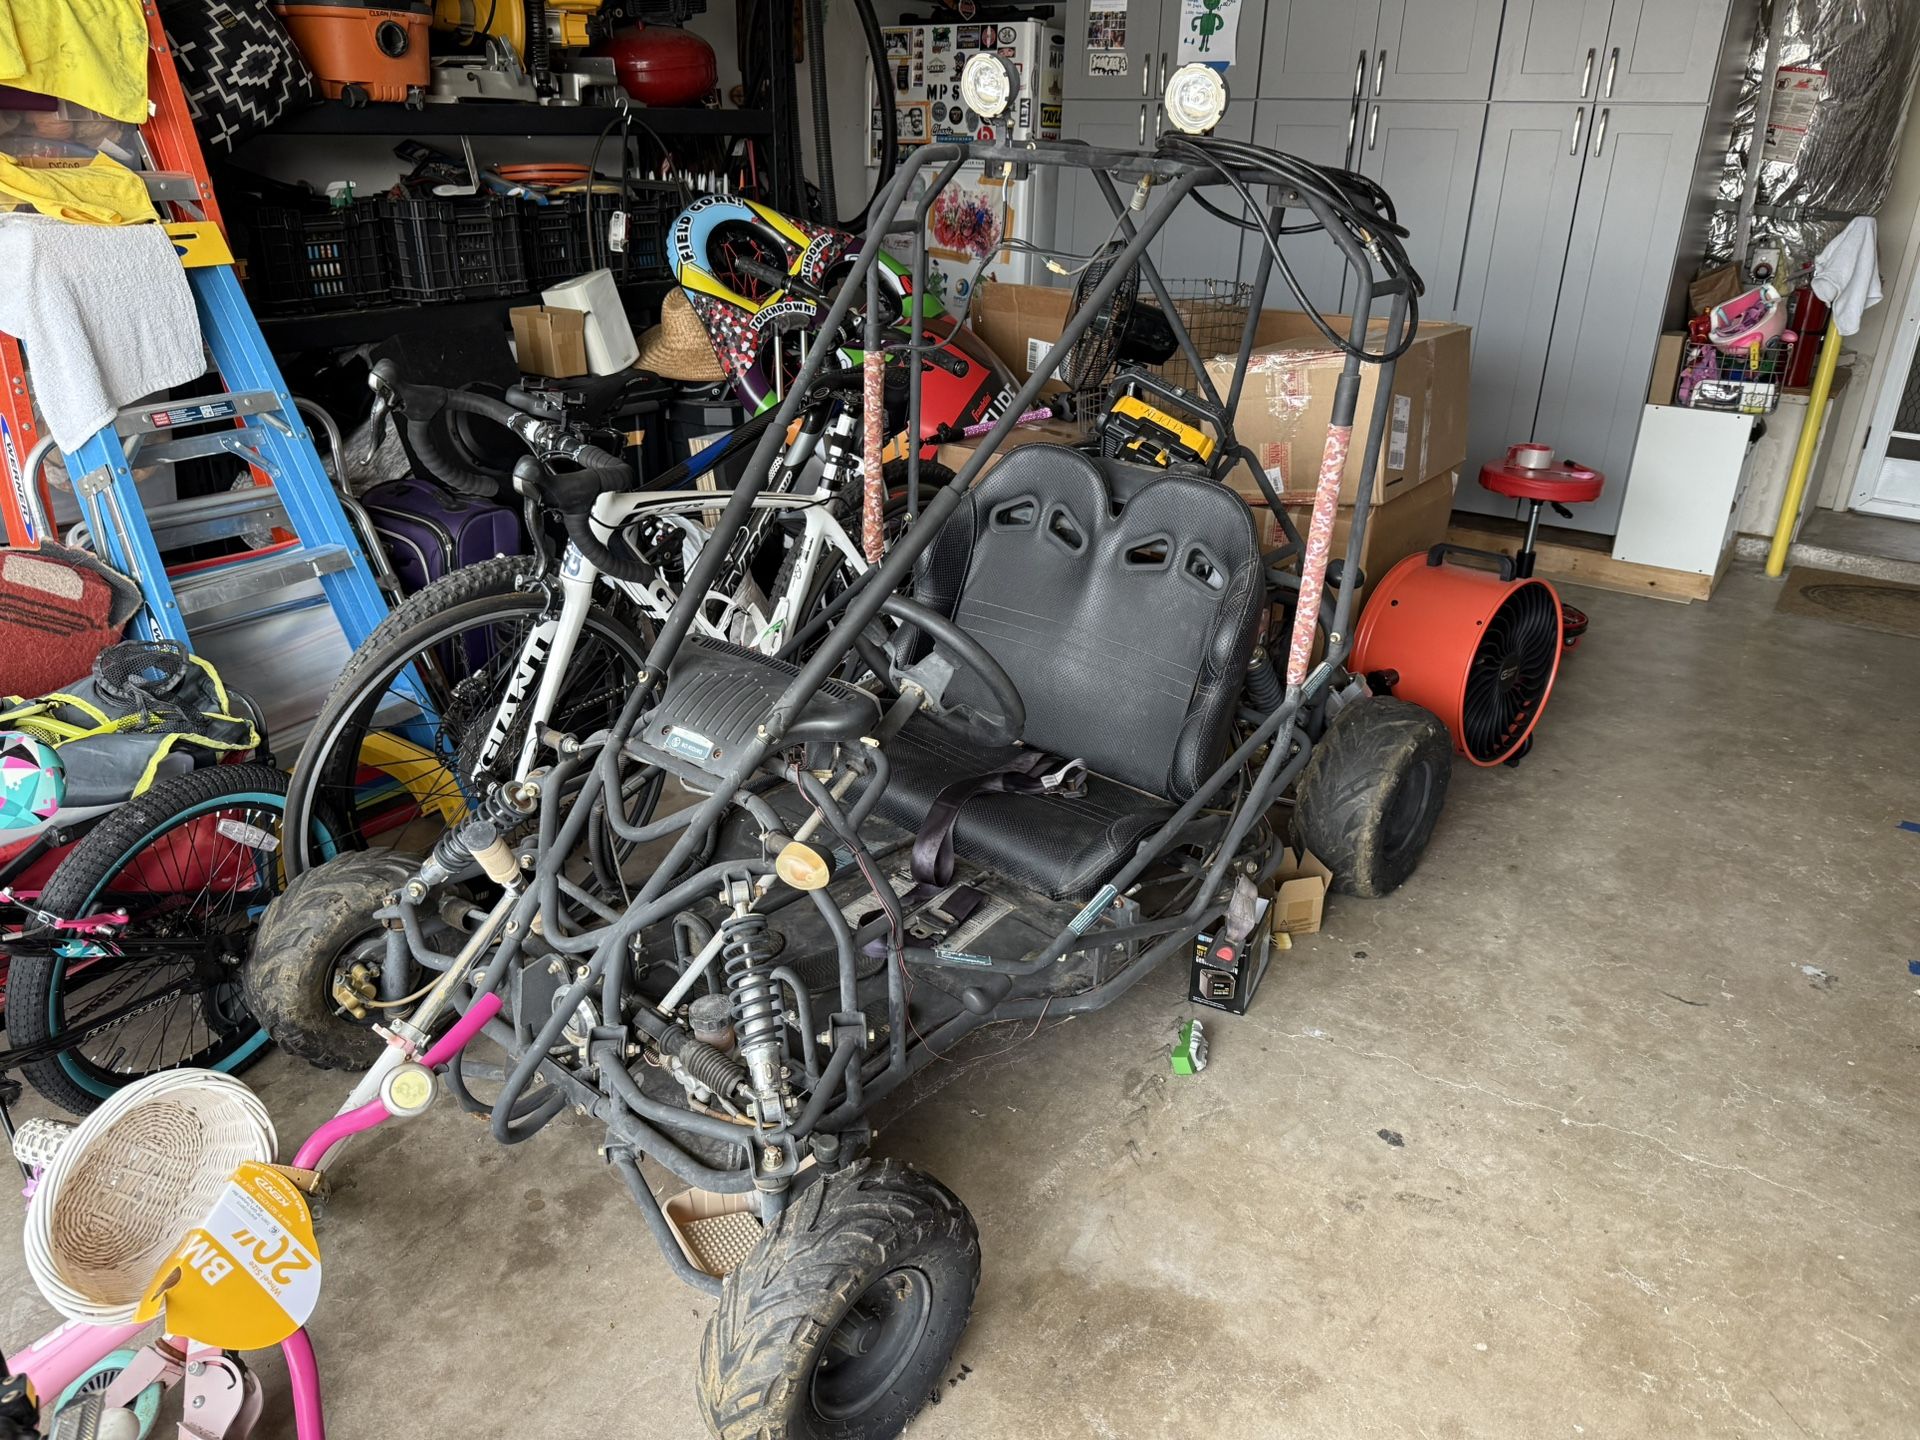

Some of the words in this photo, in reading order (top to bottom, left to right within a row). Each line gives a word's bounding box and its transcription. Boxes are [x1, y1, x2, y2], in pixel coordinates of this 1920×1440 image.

[1020, 100, 1030, 126] YETI
[675, 214, 697, 264] FIELD
[688, 194, 744, 213] GOAL!
[802, 233, 833, 282] CHDOWN!
[750, 301, 818, 332] TOUCHDOWN!
[6, 441, 28, 517] WERNER
[479, 635, 550, 772] GIANT
[260, 1179, 290, 1207] KENT
[176, 1233, 235, 1287] BM
[248, 1259, 264, 1278] Size
[263, 1276, 283, 1299] Wheel
